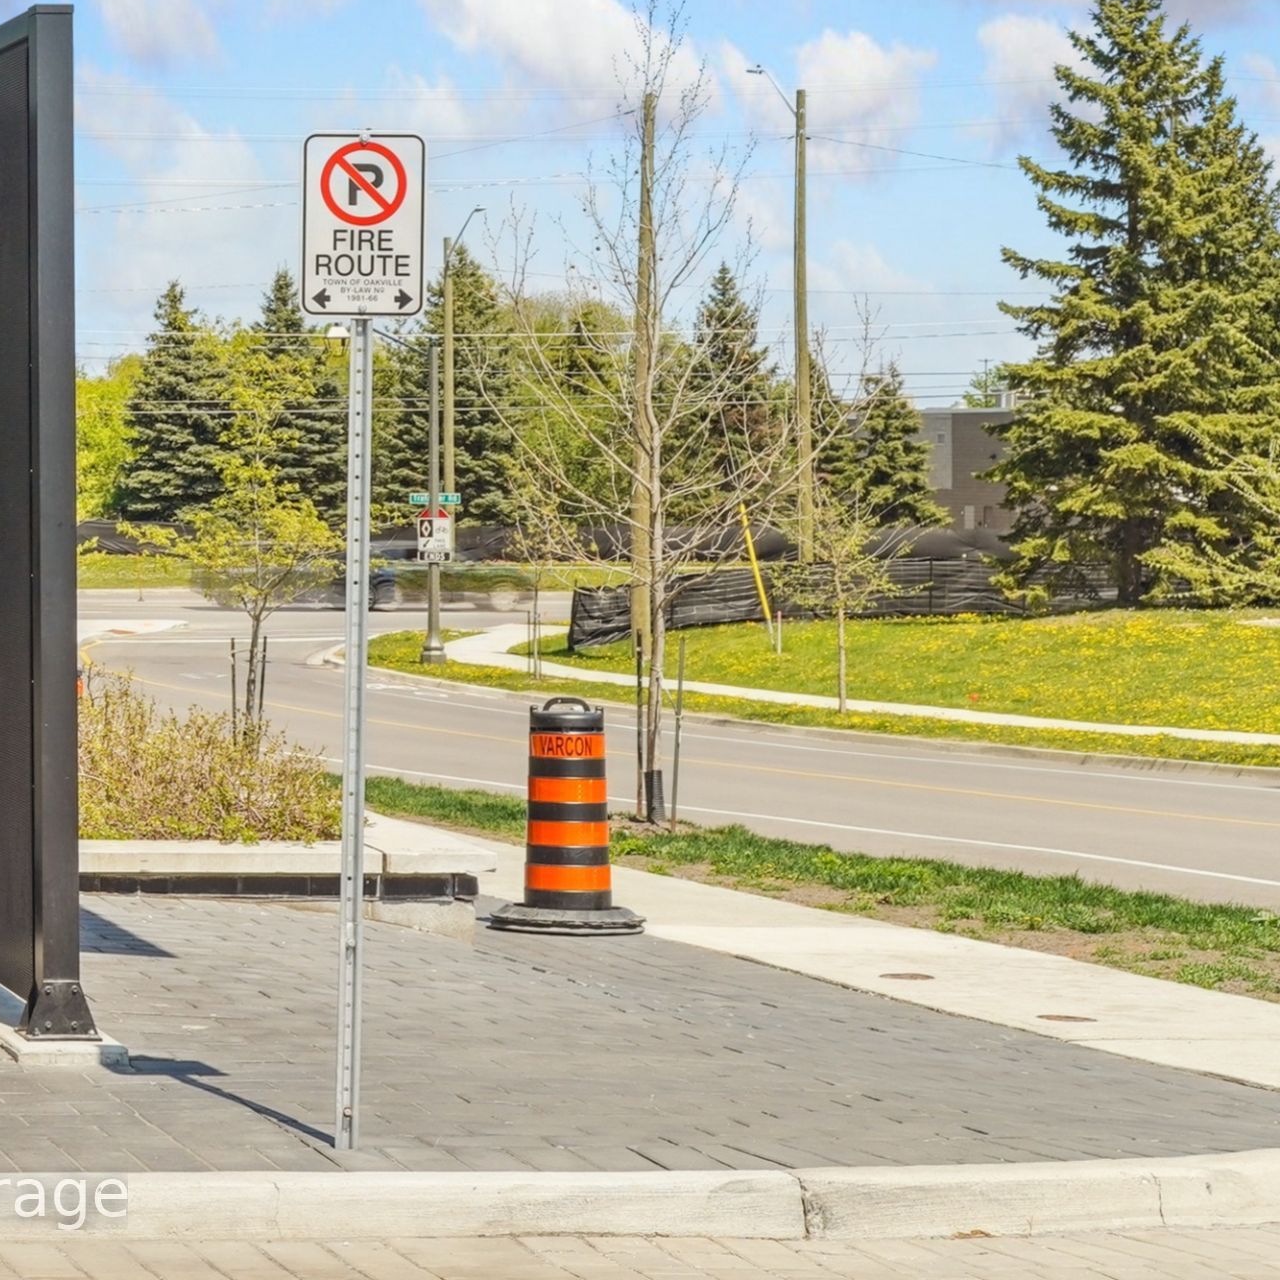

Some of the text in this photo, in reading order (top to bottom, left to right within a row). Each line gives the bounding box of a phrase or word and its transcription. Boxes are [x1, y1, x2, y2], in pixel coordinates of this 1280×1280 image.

[333, 229, 394, 251] FIRE
[315, 254, 411, 277] ROUTE
[322, 278, 403, 287] TOWN OF OAKVILLE
[340, 286, 372, 294] BY-LAW
[538, 735, 593, 757] VARCON
